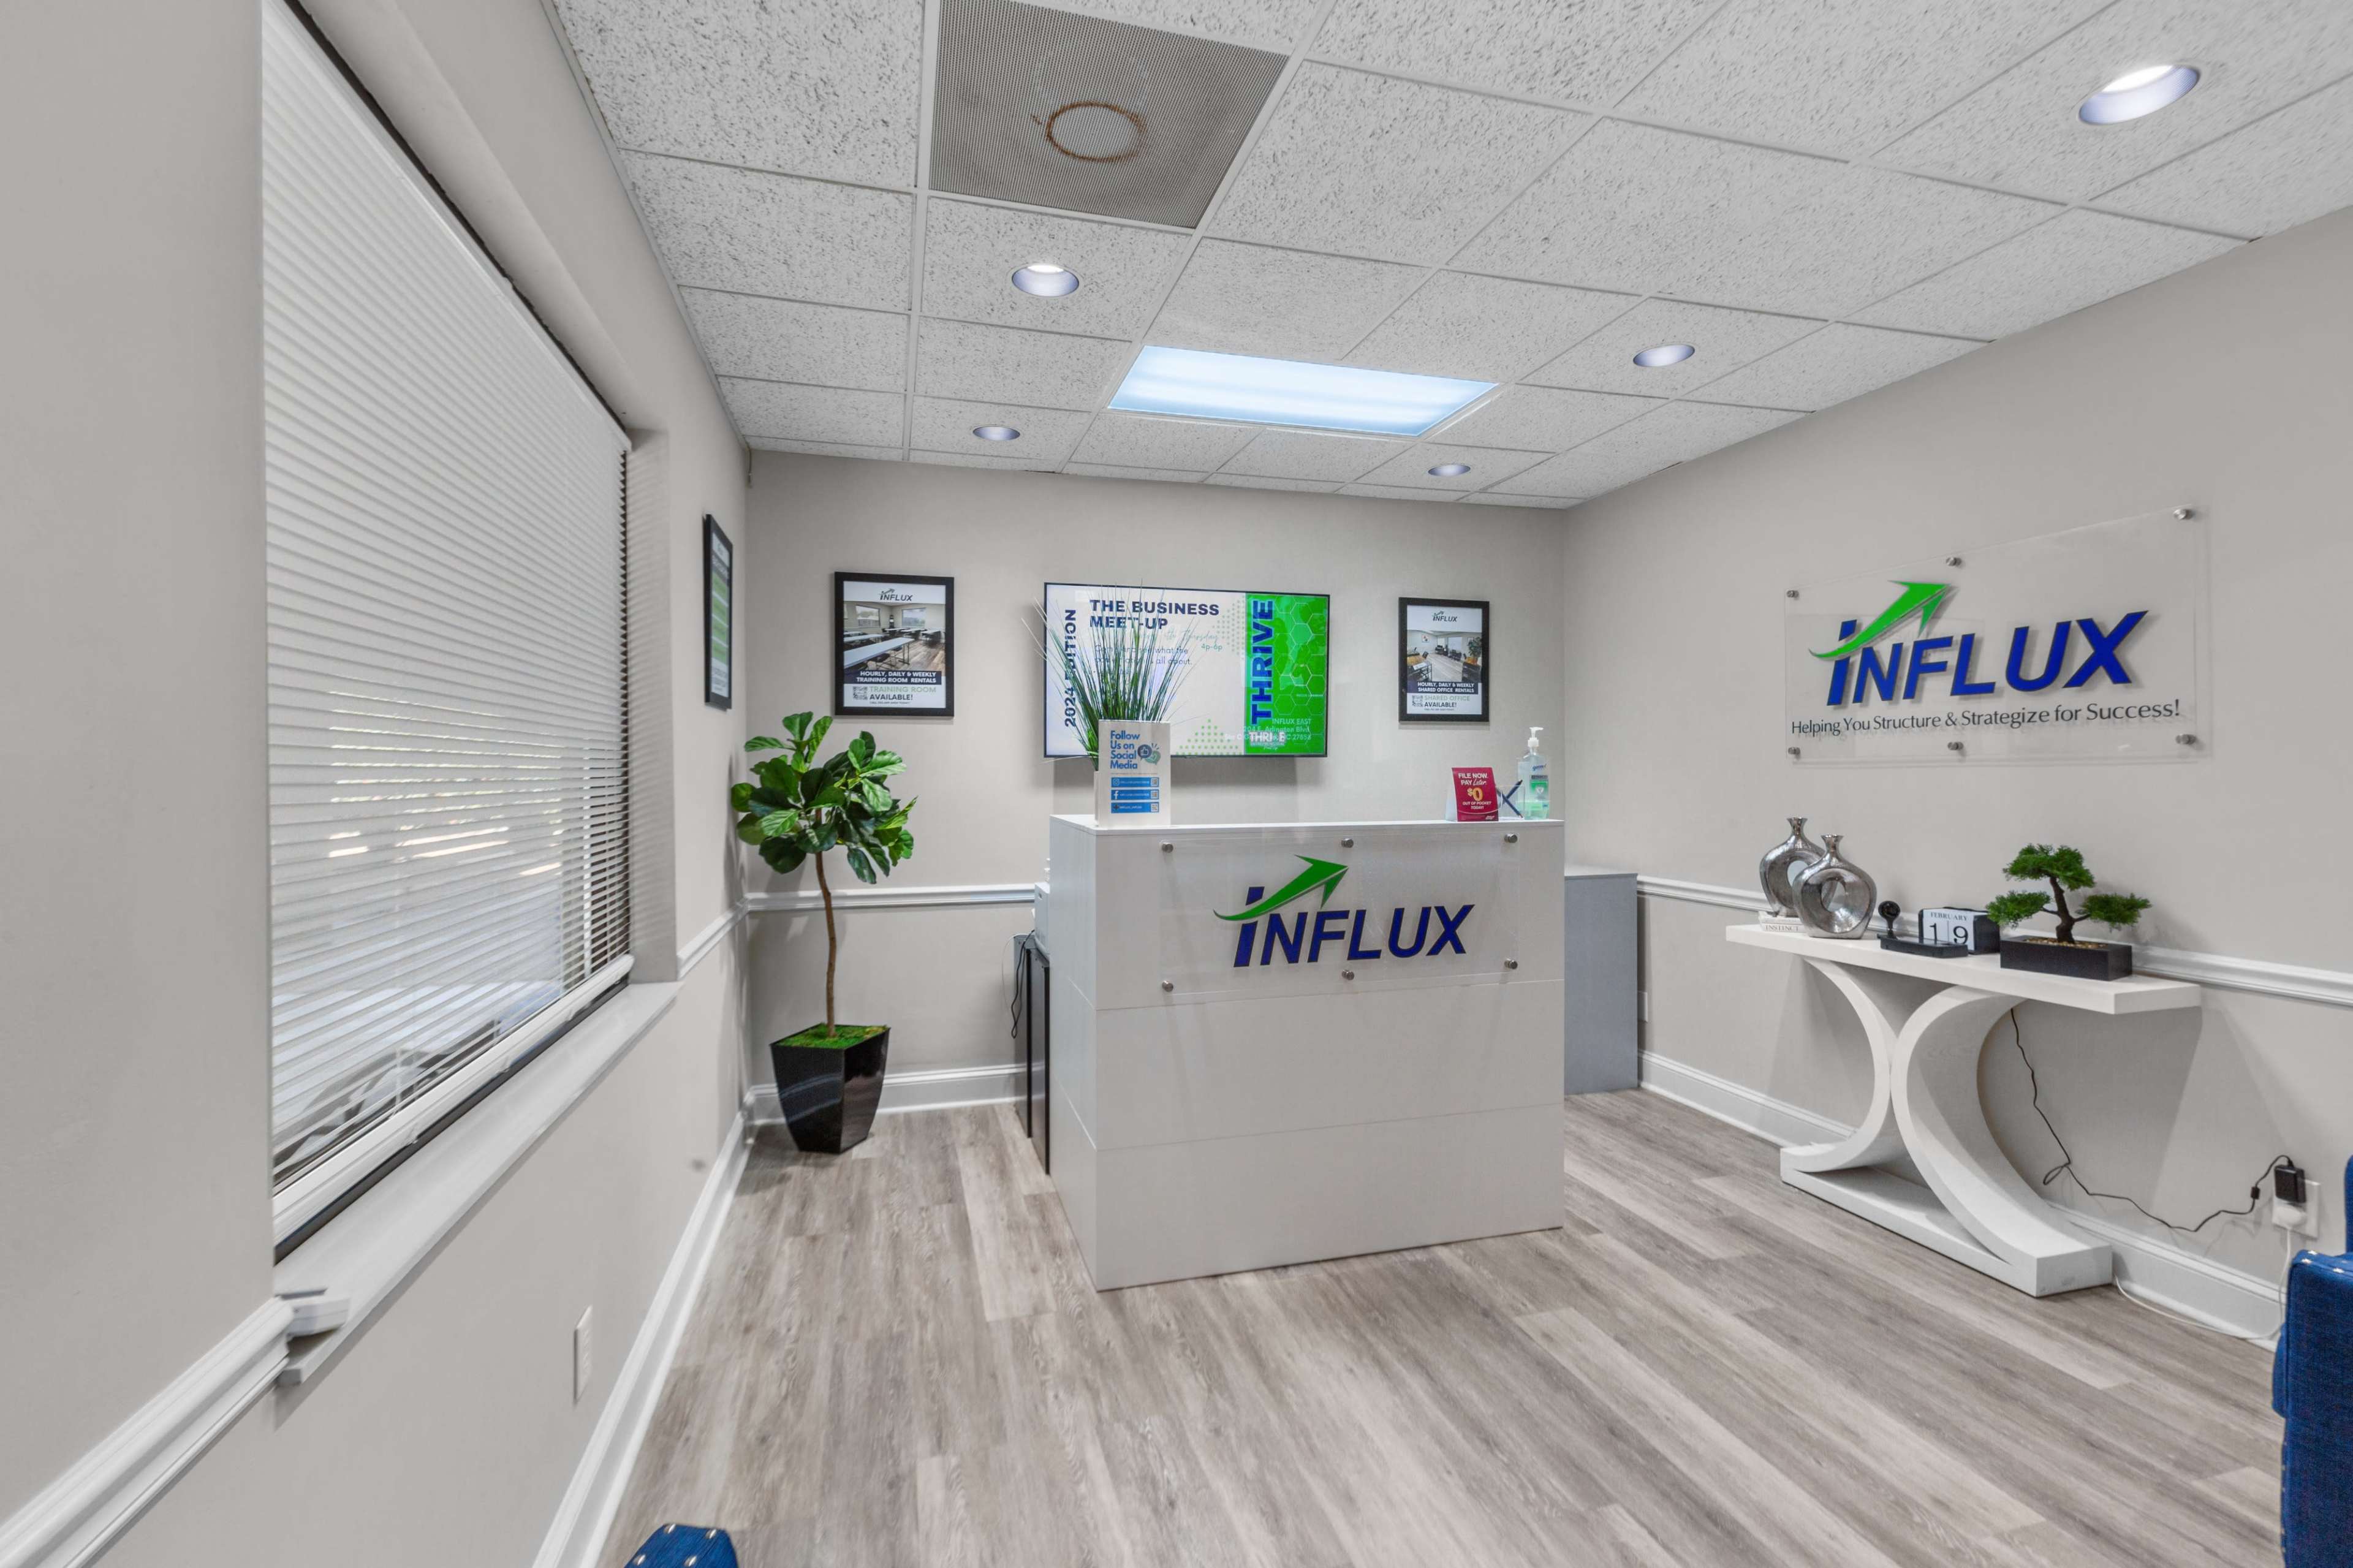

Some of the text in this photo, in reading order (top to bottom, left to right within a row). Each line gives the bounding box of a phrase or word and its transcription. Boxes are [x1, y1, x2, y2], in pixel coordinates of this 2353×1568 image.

[1089, 600, 1219, 615] THE BUSINESS
[1089, 616, 1169, 630] MEET-UP
[1252, 600, 1273, 725] THRIVE
[1065, 687, 1076, 727] 2024
[1792, 699, 2180, 737] Helping You Structure & Strategize for Success!
[1110, 730, 1140, 740] Follow
[1110, 740, 1121, 749] Us
[1110, 751, 1137, 760] Social
[1110, 760, 1138, 770] Media
[1467, 787, 1483, 801] $0
[1930, 912, 1968, 921] FEBRUARY
